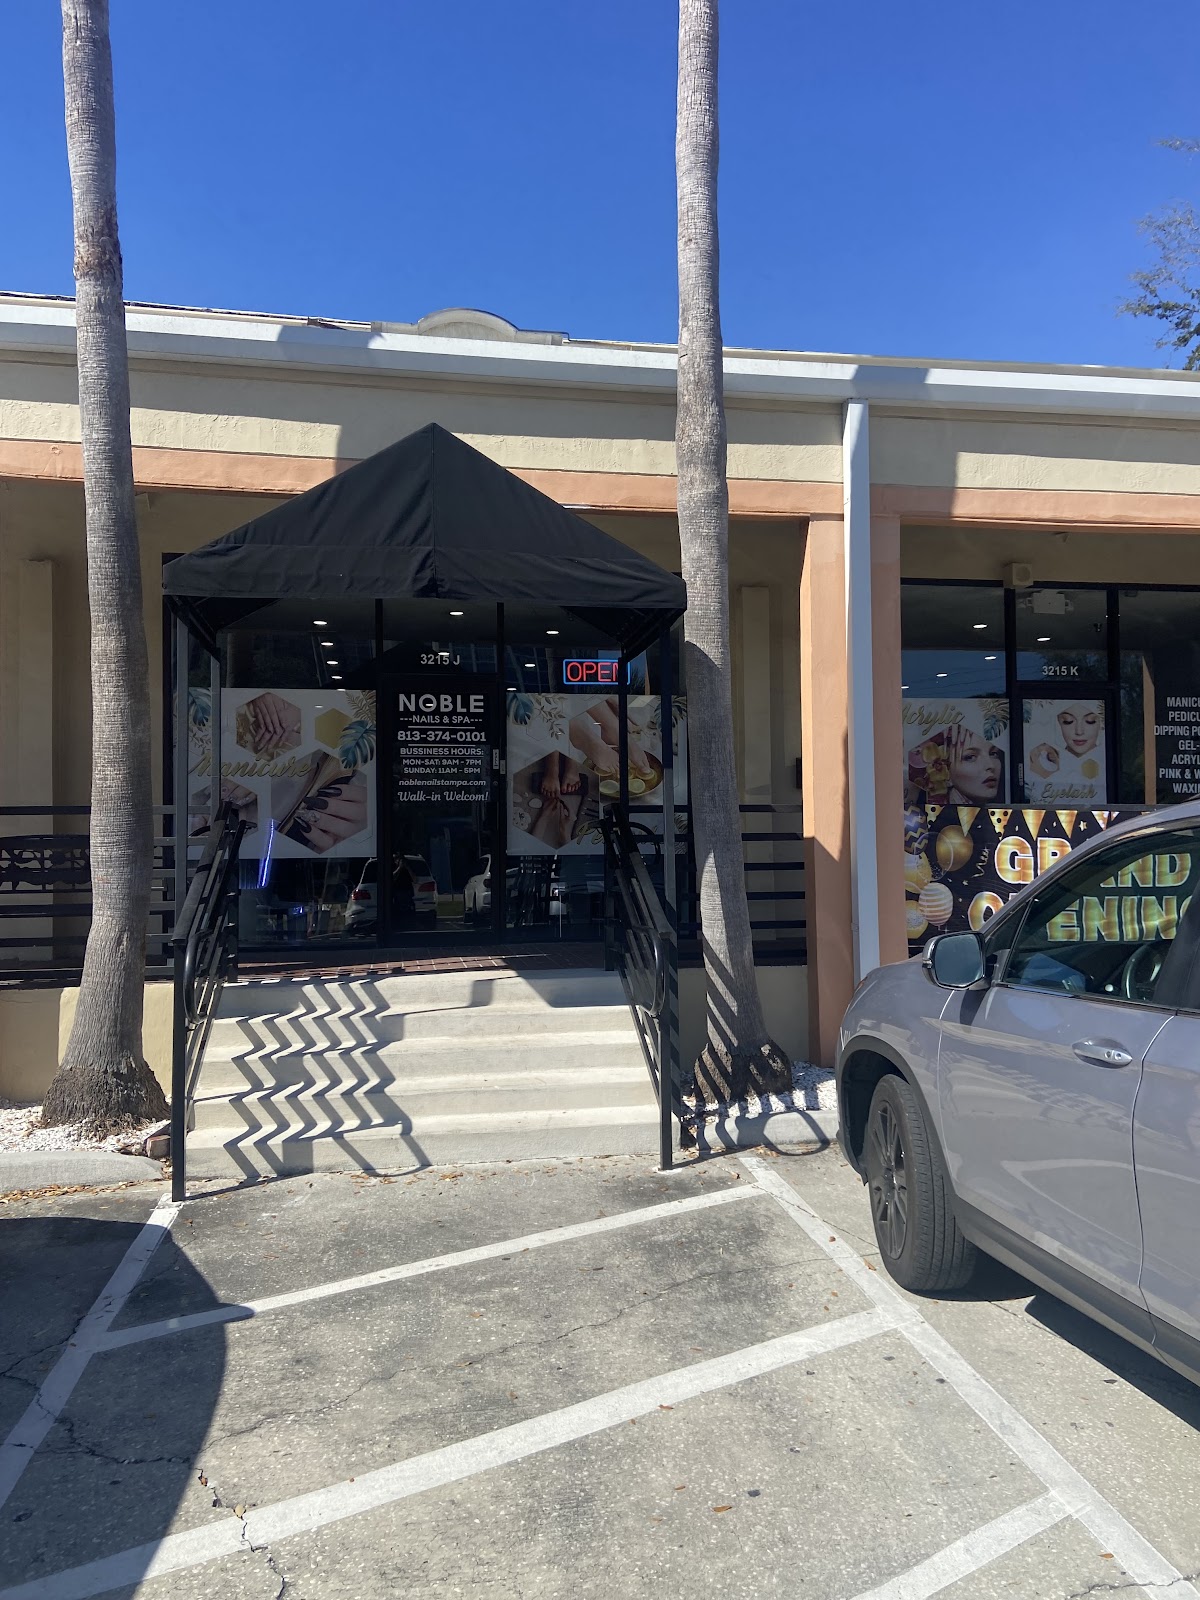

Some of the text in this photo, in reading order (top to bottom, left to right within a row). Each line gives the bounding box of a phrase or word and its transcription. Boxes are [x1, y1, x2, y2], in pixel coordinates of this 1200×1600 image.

[420, 653, 461, 666] 3215 J
[1042, 665, 1079, 676] 3215 K
[398, 693, 484, 713] NOBLE
[442, 715, 450, 724] &
[1154, 725, 1190, 736] DIPPING
[397, 731, 487, 742] 813-374-0101
[400, 747, 484, 756] BUSSINESS HOURS:
[402, 758, 441, 766] MON-SAT:
[442, 758, 459, 766] 9AM
[1159, 767, 1182, 779] PINK
[1184, 768, 1192, 780] &
[398, 778, 487, 787] noblenailstampa.com
[397, 790, 489, 802] Walk-in Welcom!
[1040, 783, 1098, 803] Eyelash
